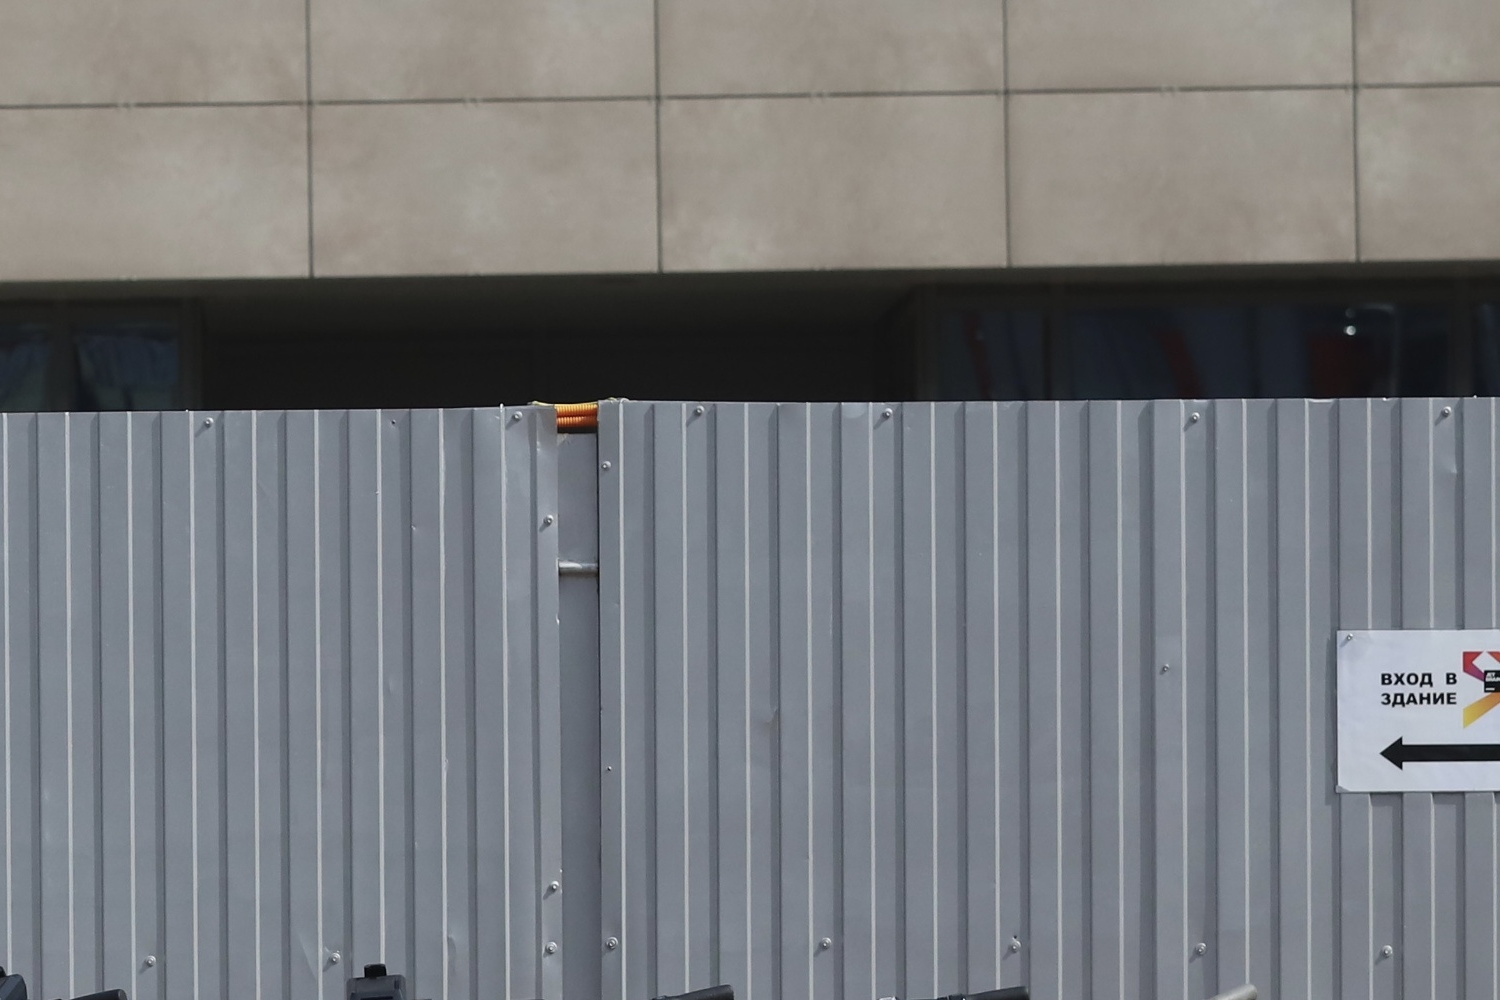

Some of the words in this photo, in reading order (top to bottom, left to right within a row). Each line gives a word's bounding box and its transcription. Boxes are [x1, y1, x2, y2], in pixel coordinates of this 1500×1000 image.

[1380, 673, 1433, 688] ВХОД
[1445, 673, 1458, 686] В
[1380, 693, 1457, 707] ЗДАНИЕ
